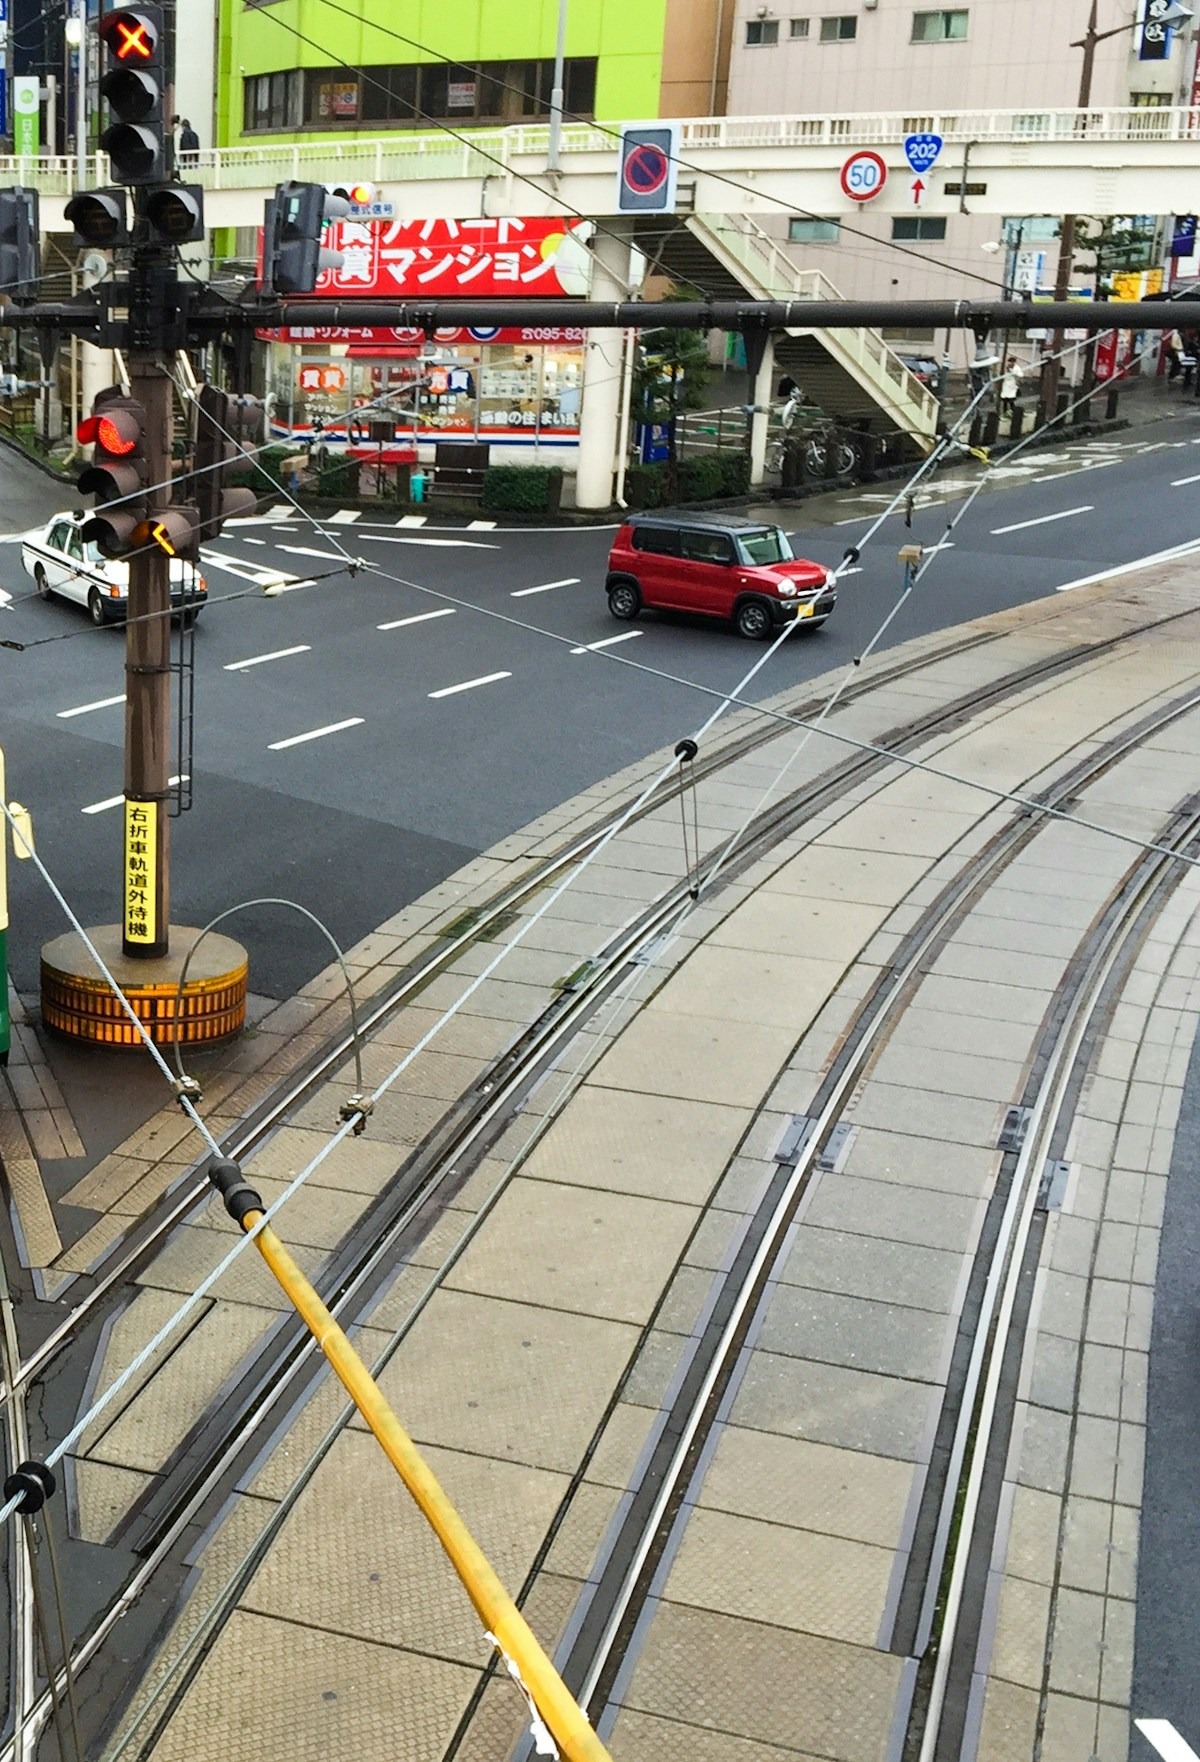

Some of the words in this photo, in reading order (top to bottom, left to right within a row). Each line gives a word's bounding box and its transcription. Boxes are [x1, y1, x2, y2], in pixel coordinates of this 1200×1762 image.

[908, 143, 938, 159] 202
[850, 165, 877, 187] 50
[380, 244, 558, 284] マンション
[128, 807, 148, 937] 右折車軌道外待機
